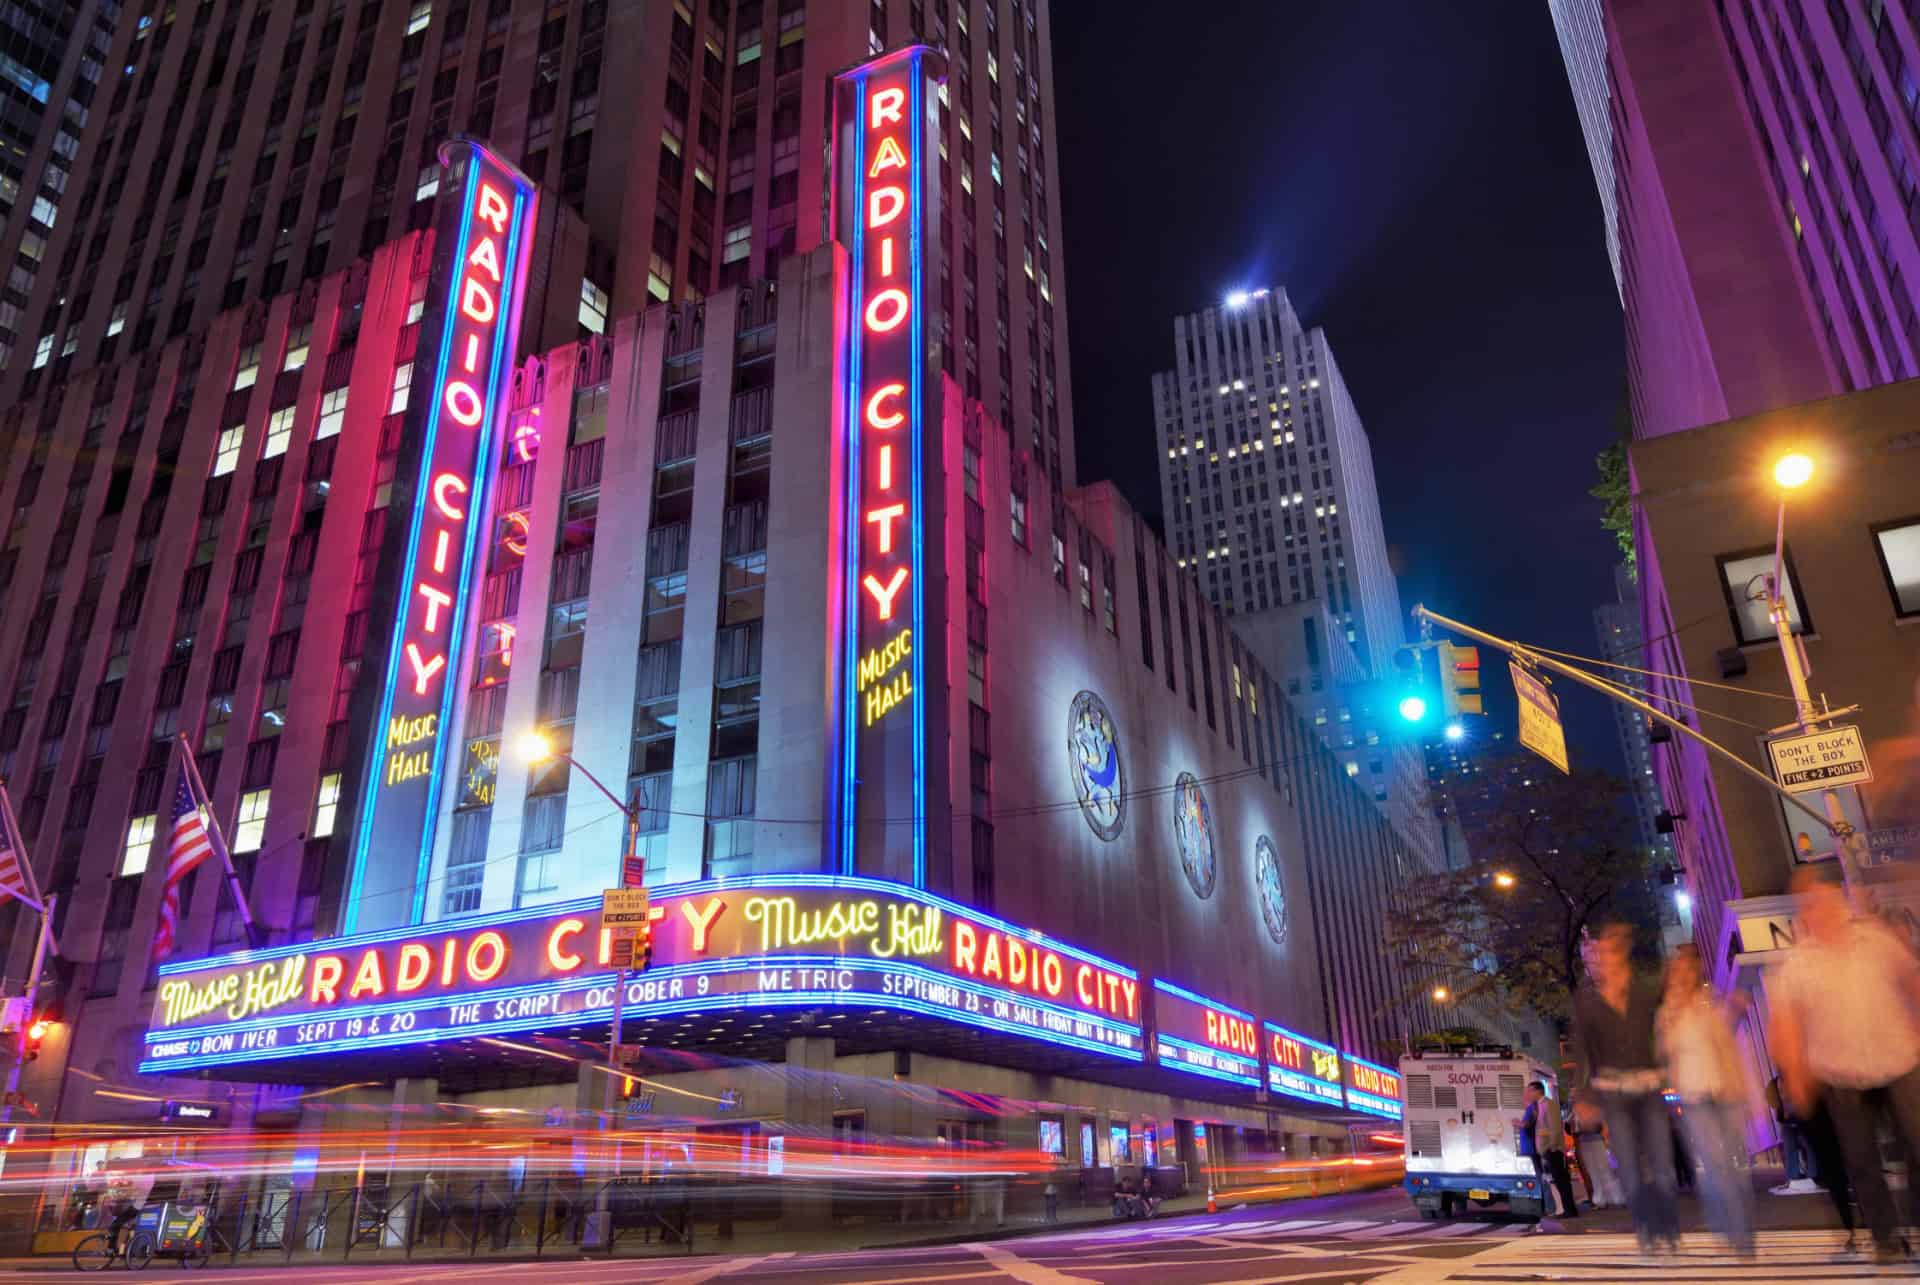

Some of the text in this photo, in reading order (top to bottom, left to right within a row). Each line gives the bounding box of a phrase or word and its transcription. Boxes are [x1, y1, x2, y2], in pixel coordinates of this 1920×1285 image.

[863, 87, 909, 620] RADIO CITY
[406, 183, 508, 695] RADIO CITY
[859, 629, 912, 692] MUSIC
[866, 669, 912, 727] HALL
[387, 713, 437, 750] MUSIC
[1779, 736, 1854, 759] DON'T BLOCK
[387, 751, 430, 787] HALL
[1786, 771, 1809, 785] FINE
[1828, 761, 1863, 777] POINTS
[1795, 749, 1846, 768] THE BOX
[743, 896, 944, 958] Music Hall
[310, 930, 506, 1003] RADIO
[758, 969, 854, 992] METRIC
[955, 920, 1137, 1018] RADIO CITY
[160, 955, 306, 1026] Music Hall
[449, 975, 710, 1026] THE SCRIPT OCOBER 9
[882, 972, 960, 1008] SEPTEMBER
[964, 991, 980, 1012] 23
[992, 998, 1010, 1019] ON
[1014, 1004, 1039, 1027] SALE
[151, 1040, 189, 1059] CHASE
[200, 1033, 235, 1056] BON
[241, 1028, 278, 1050] IVER
[296, 1021, 338, 1044] SEPT
[345, 1017, 363, 1038] 19
[389, 1011, 417, 1034] 20
[1205, 1010, 1257, 1055] RADIO
[1273, 1033, 1302, 1070] CITY
[1353, 1063, 1379, 1093] RADIO
[1381, 1072, 1399, 1099] CITY
